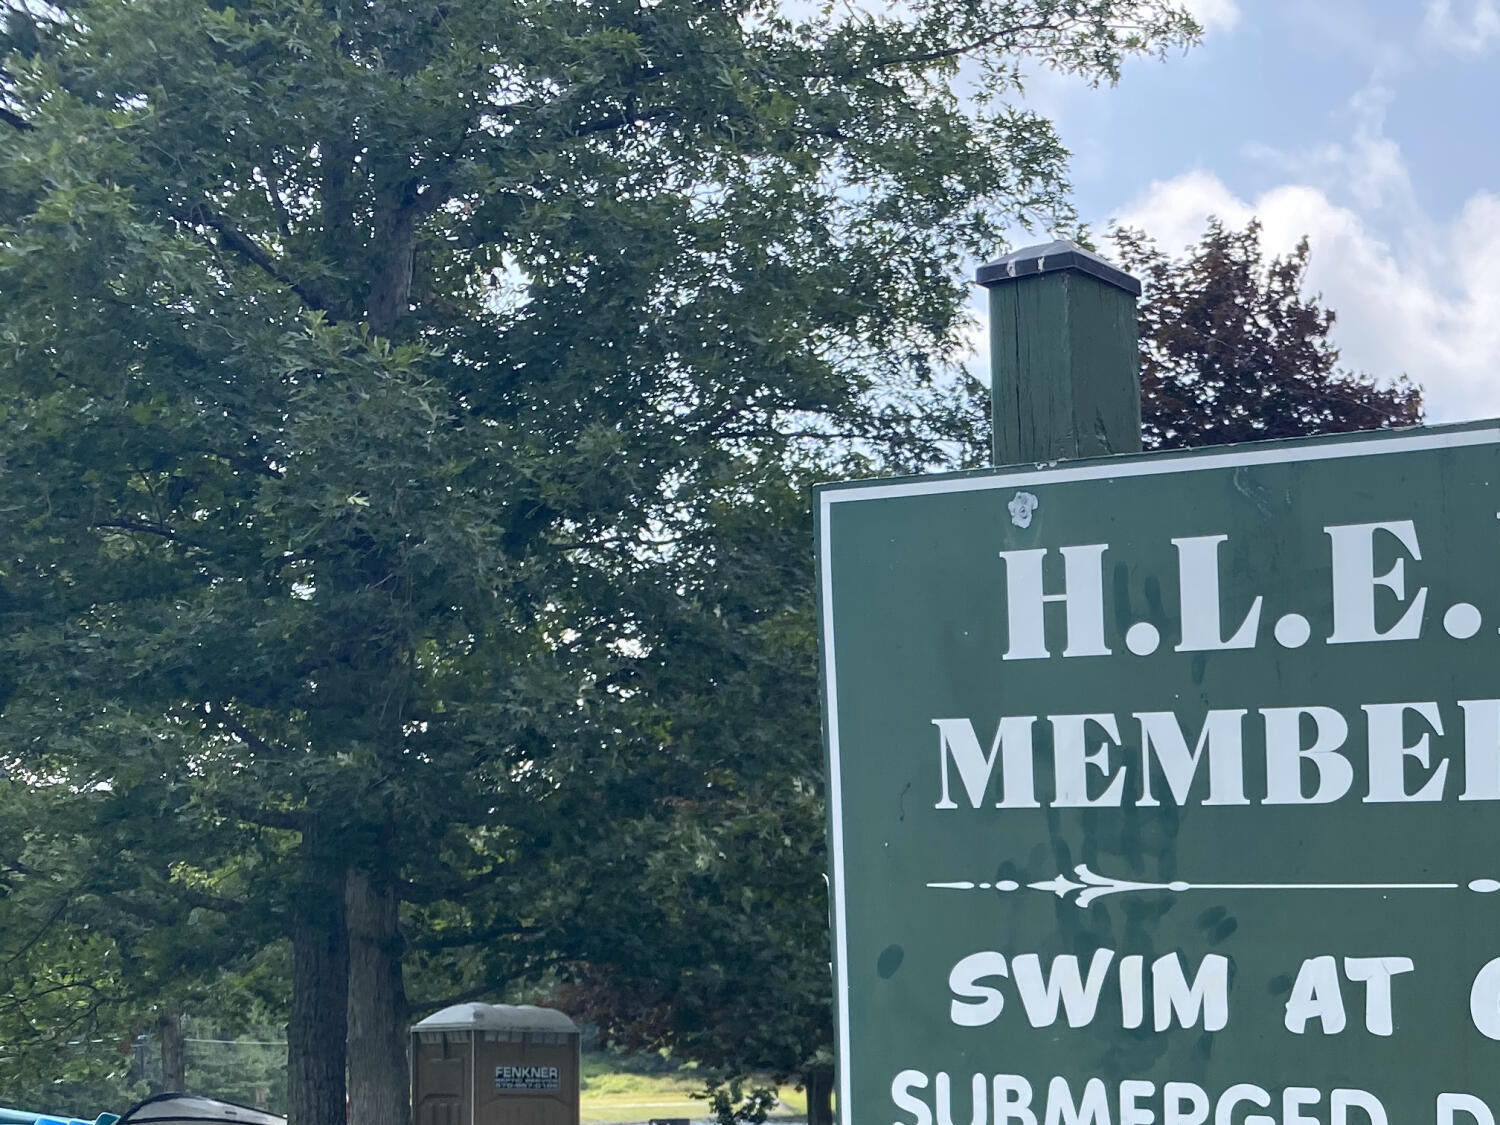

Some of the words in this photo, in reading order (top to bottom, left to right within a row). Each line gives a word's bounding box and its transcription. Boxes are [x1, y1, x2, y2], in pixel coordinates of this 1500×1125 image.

[948, 947, 1229, 1034] SWIM
[1284, 955, 1415, 1037] AT
[495, 1066, 558, 1079] FENKNER
